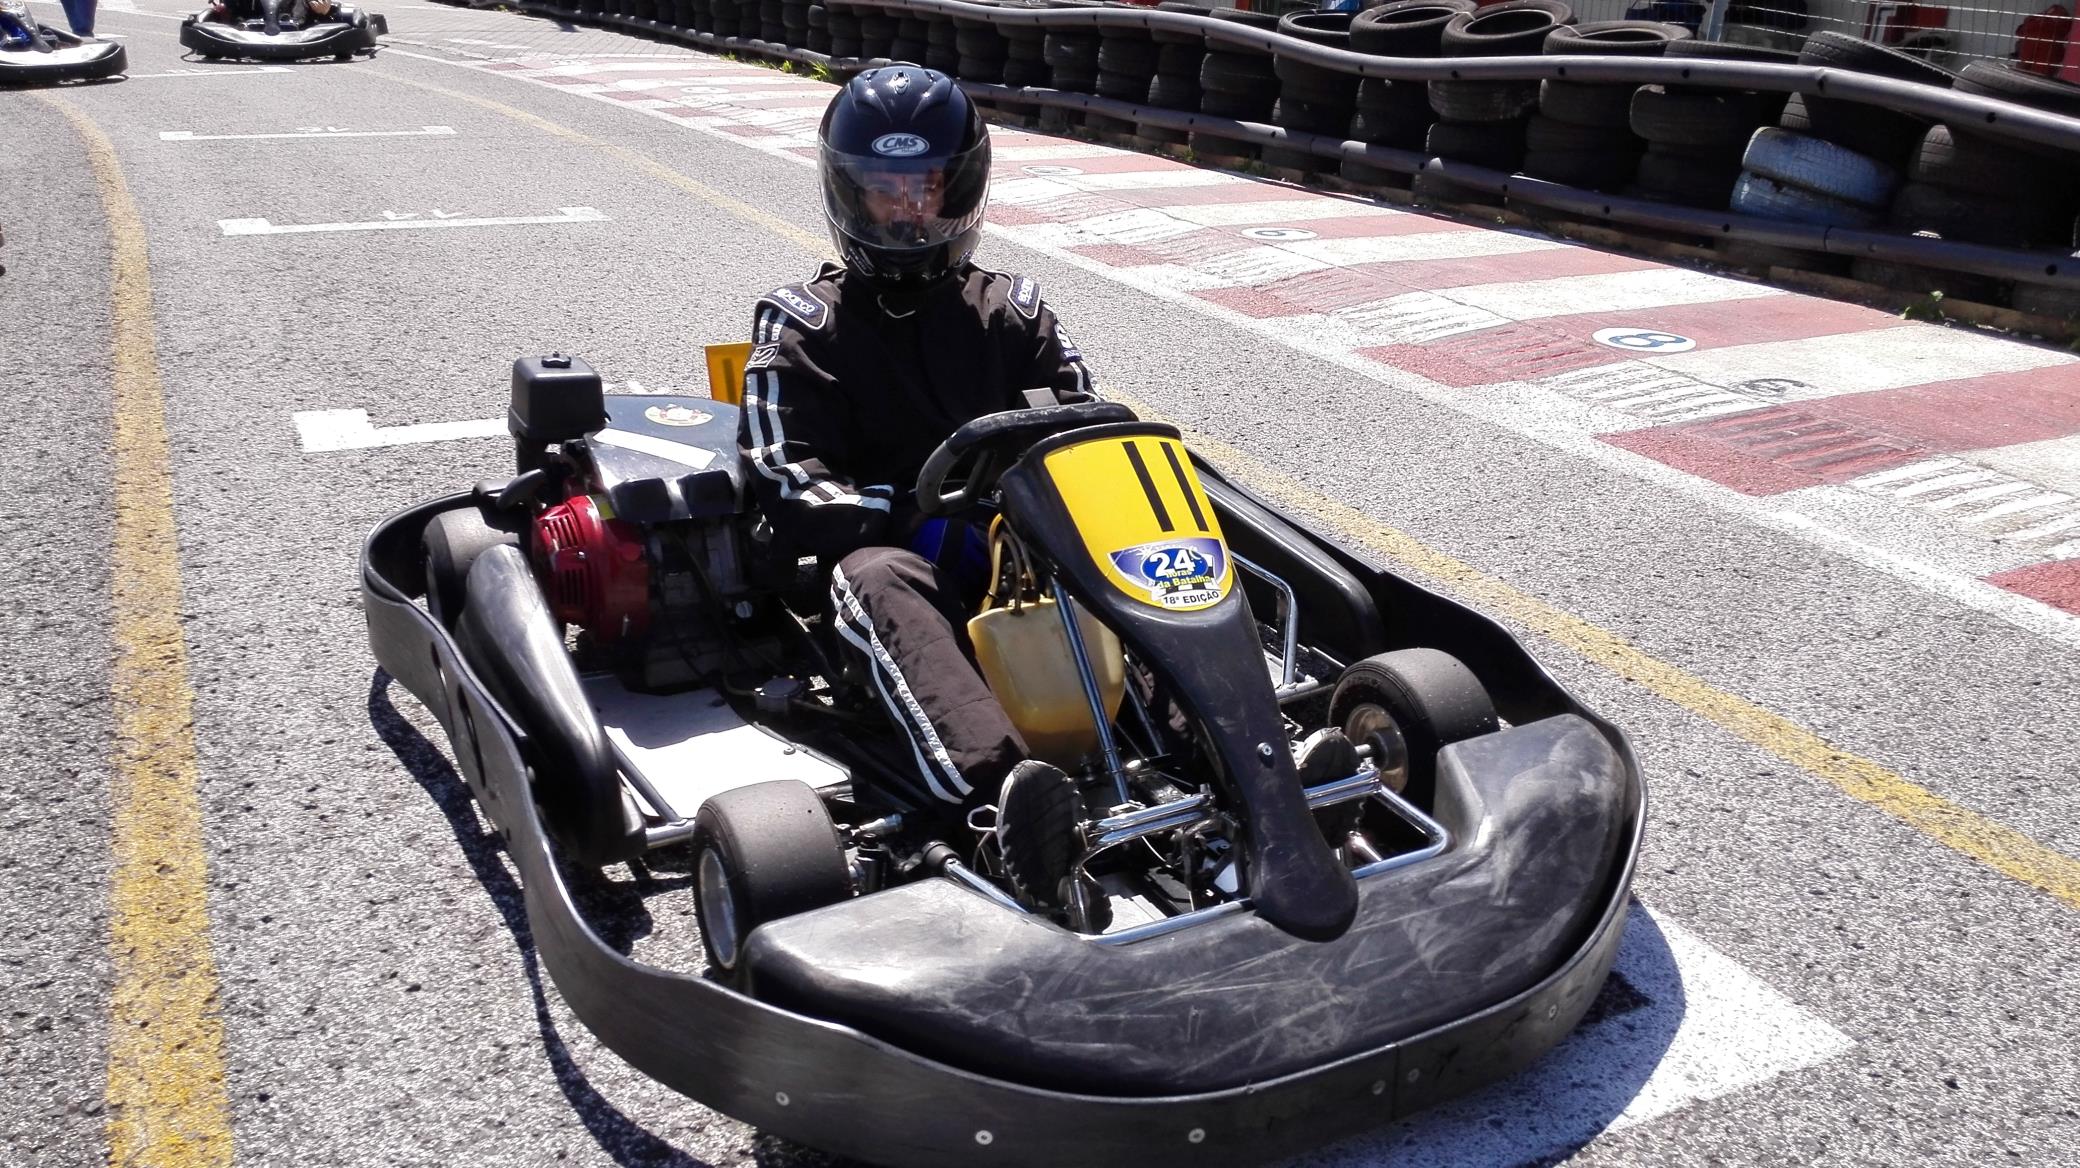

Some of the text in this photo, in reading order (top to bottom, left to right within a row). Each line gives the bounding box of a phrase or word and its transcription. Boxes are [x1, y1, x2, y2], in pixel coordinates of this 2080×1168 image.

[882, 137, 918, 149] CMS
[1121, 441, 1210, 532] 11
[1149, 549, 1196, 577] 24
[1157, 574, 1212, 589] da Batalha
[1183, 590, 1220, 604] EDIÇÃO
